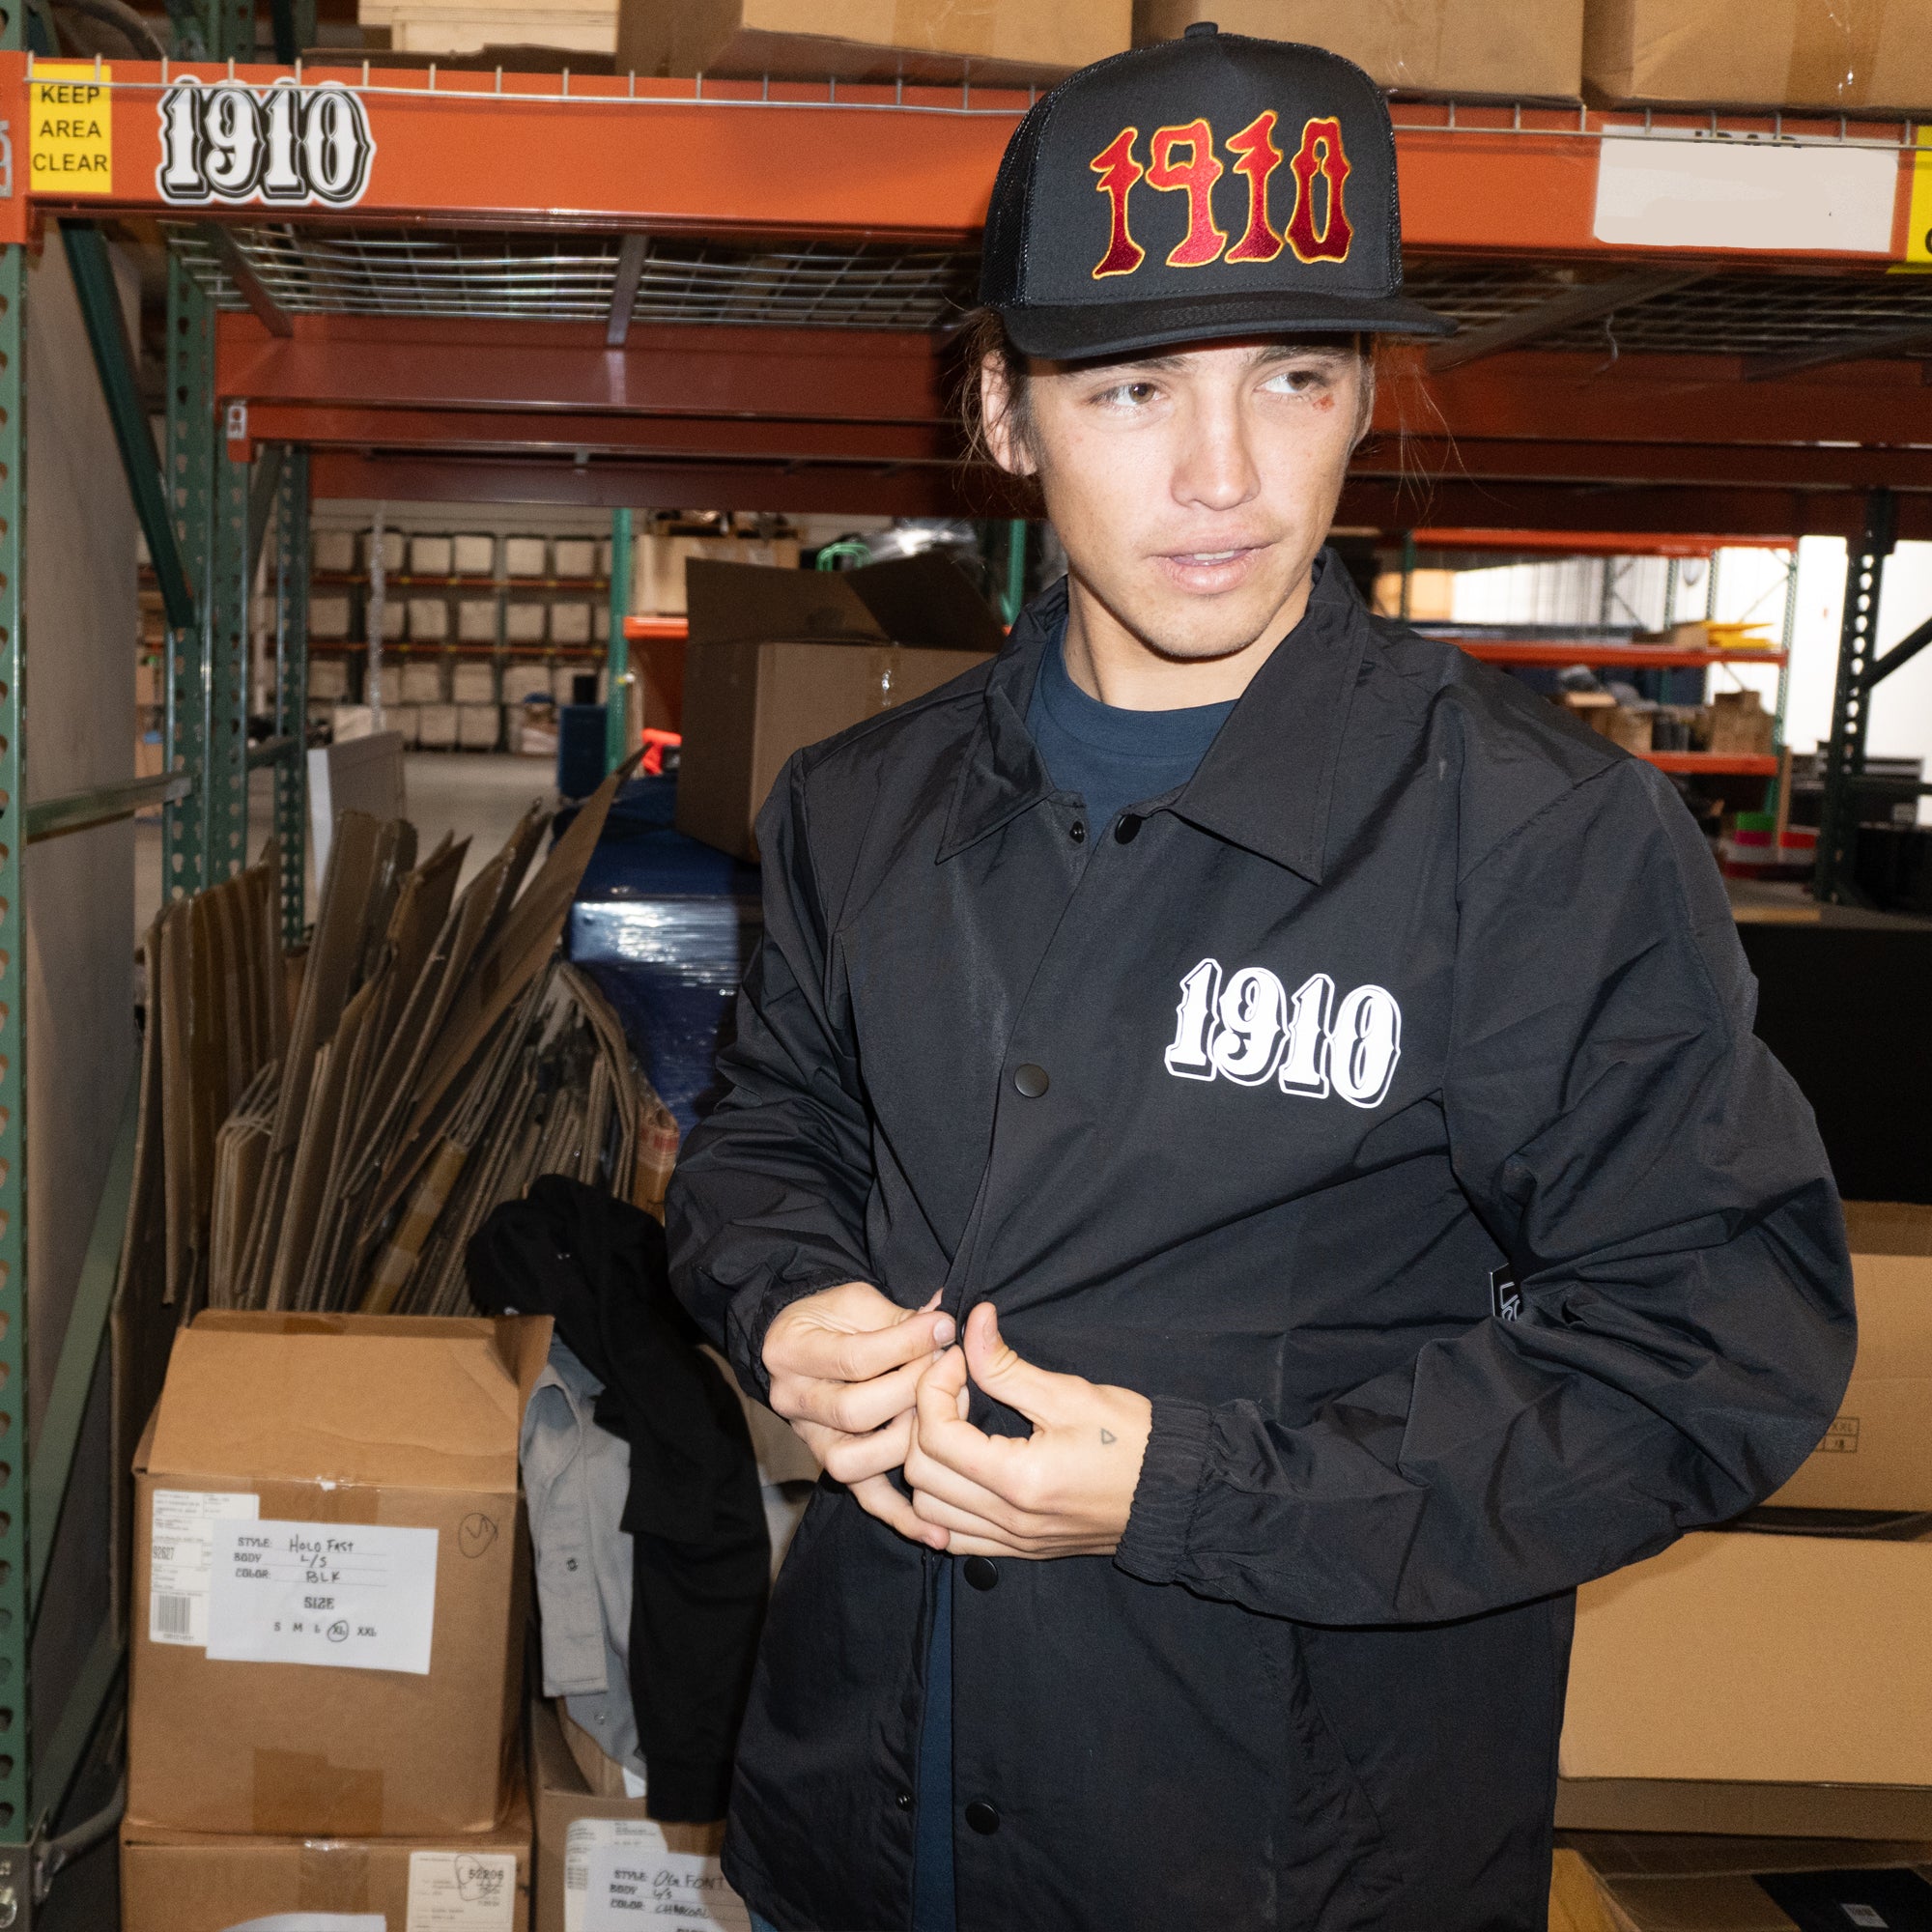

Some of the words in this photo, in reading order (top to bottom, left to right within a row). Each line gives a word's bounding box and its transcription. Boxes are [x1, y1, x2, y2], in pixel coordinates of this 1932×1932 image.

[41, 85, 99, 103] KEEP
[40, 120, 101, 138] AREA
[157, 75, 375, 207] 1910
[33, 153, 108, 172] CLEAR
[1090, 109, 1353, 279] 1910
[1164, 957, 1402, 1109] 1910
[305, 1570, 340, 1584] BLK
[303, 1597, 335, 1609] SIZE
[273, 1622, 281, 1632] S
[293, 1623, 303, 1633] M
